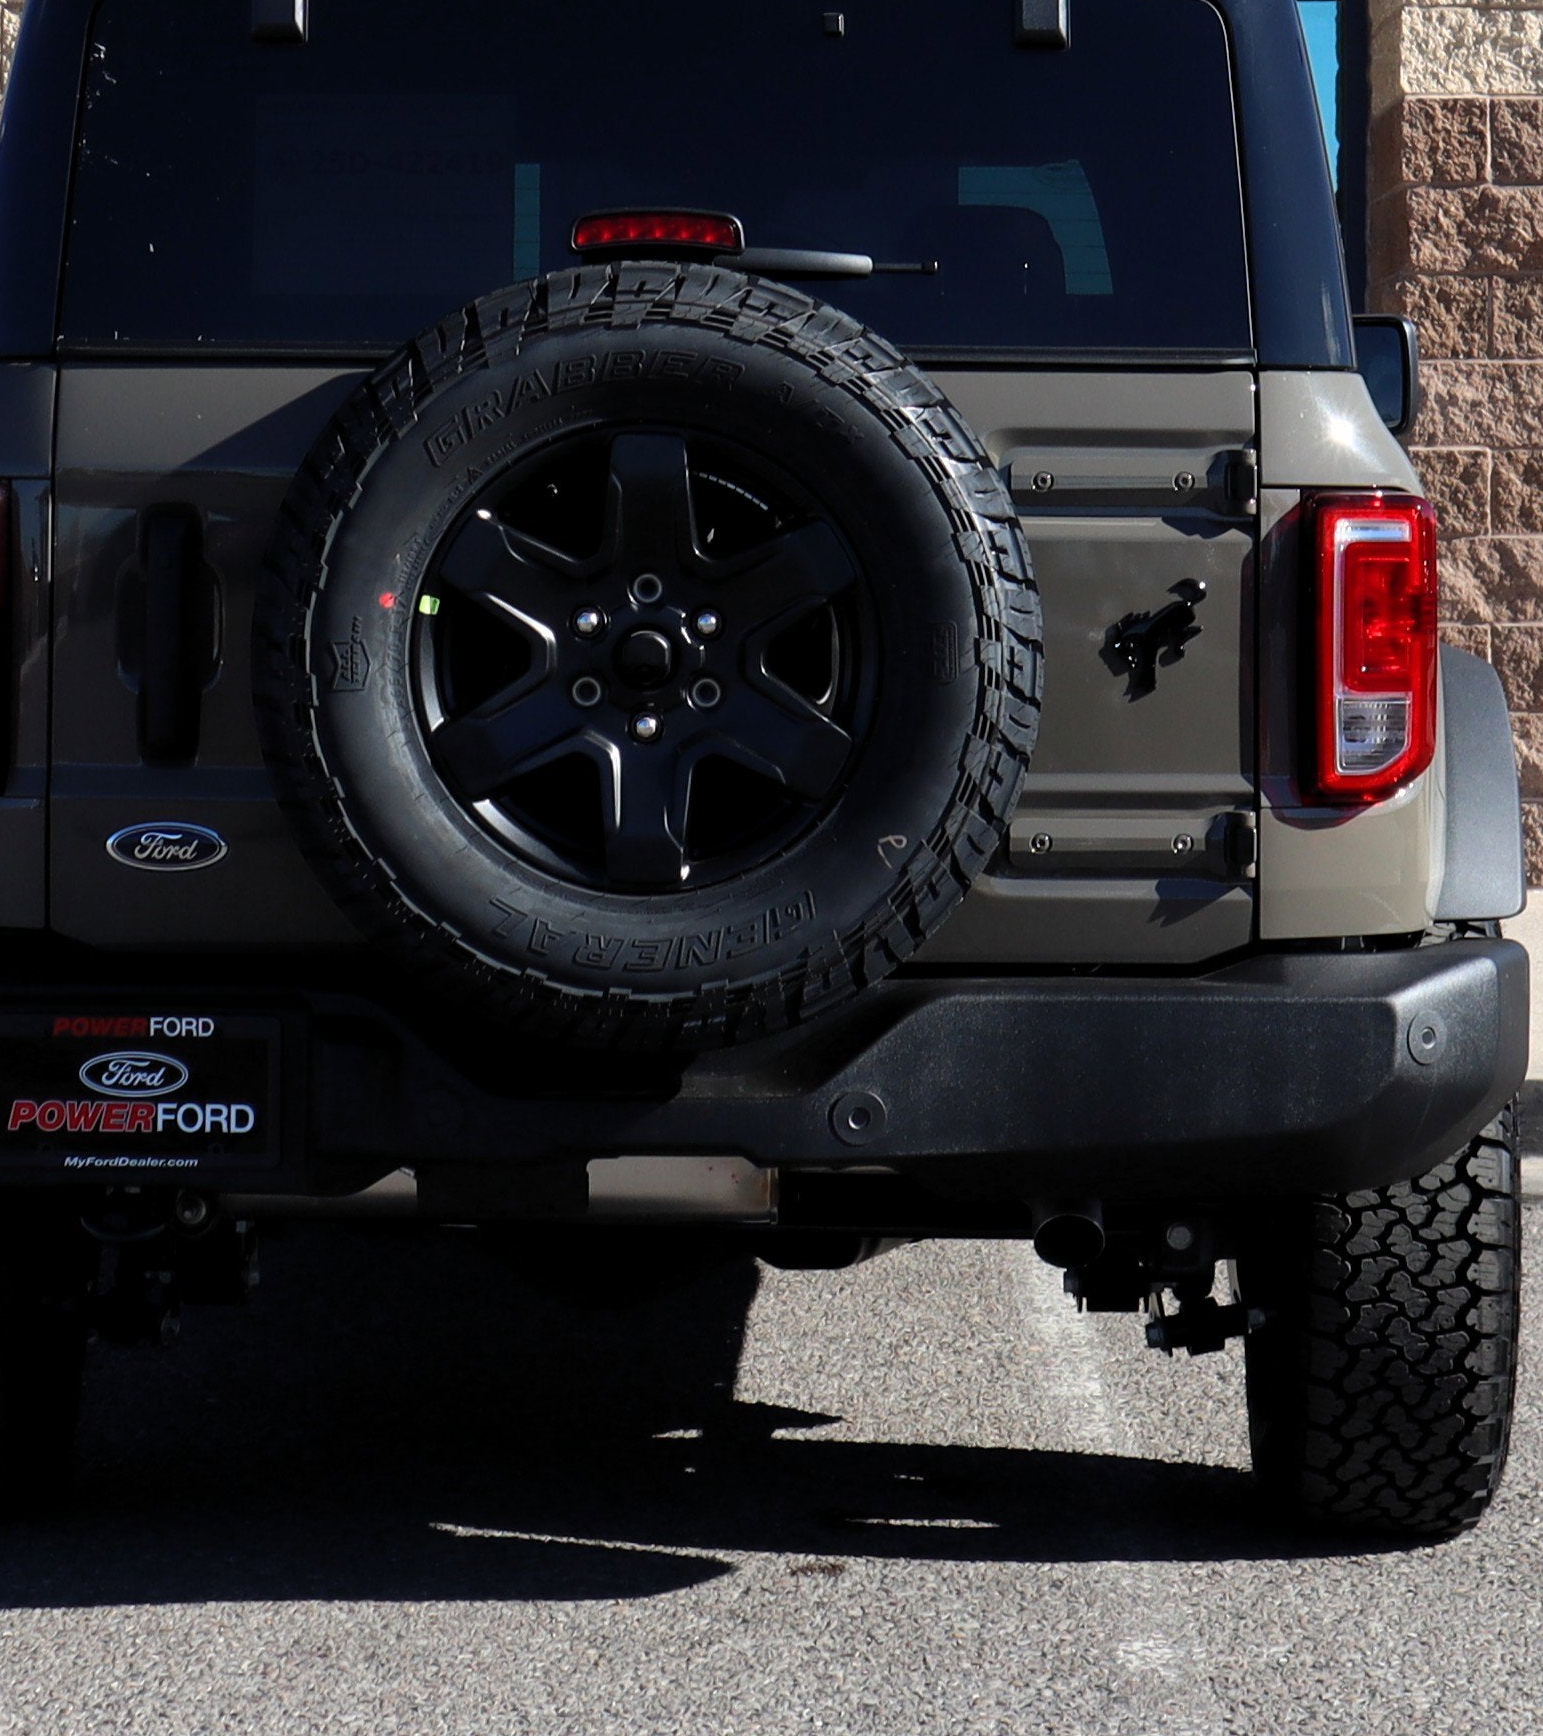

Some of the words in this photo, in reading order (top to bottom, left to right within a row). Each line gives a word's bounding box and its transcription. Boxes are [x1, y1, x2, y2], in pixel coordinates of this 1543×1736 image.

[421, 347, 747, 468] GRABBER
[134, 831, 198, 861] Ford
[488, 888, 817, 974] GENERAL
[100, 1060, 165, 1088] Ford
[63, 1155, 199, 1170] MyFordDealer.com
